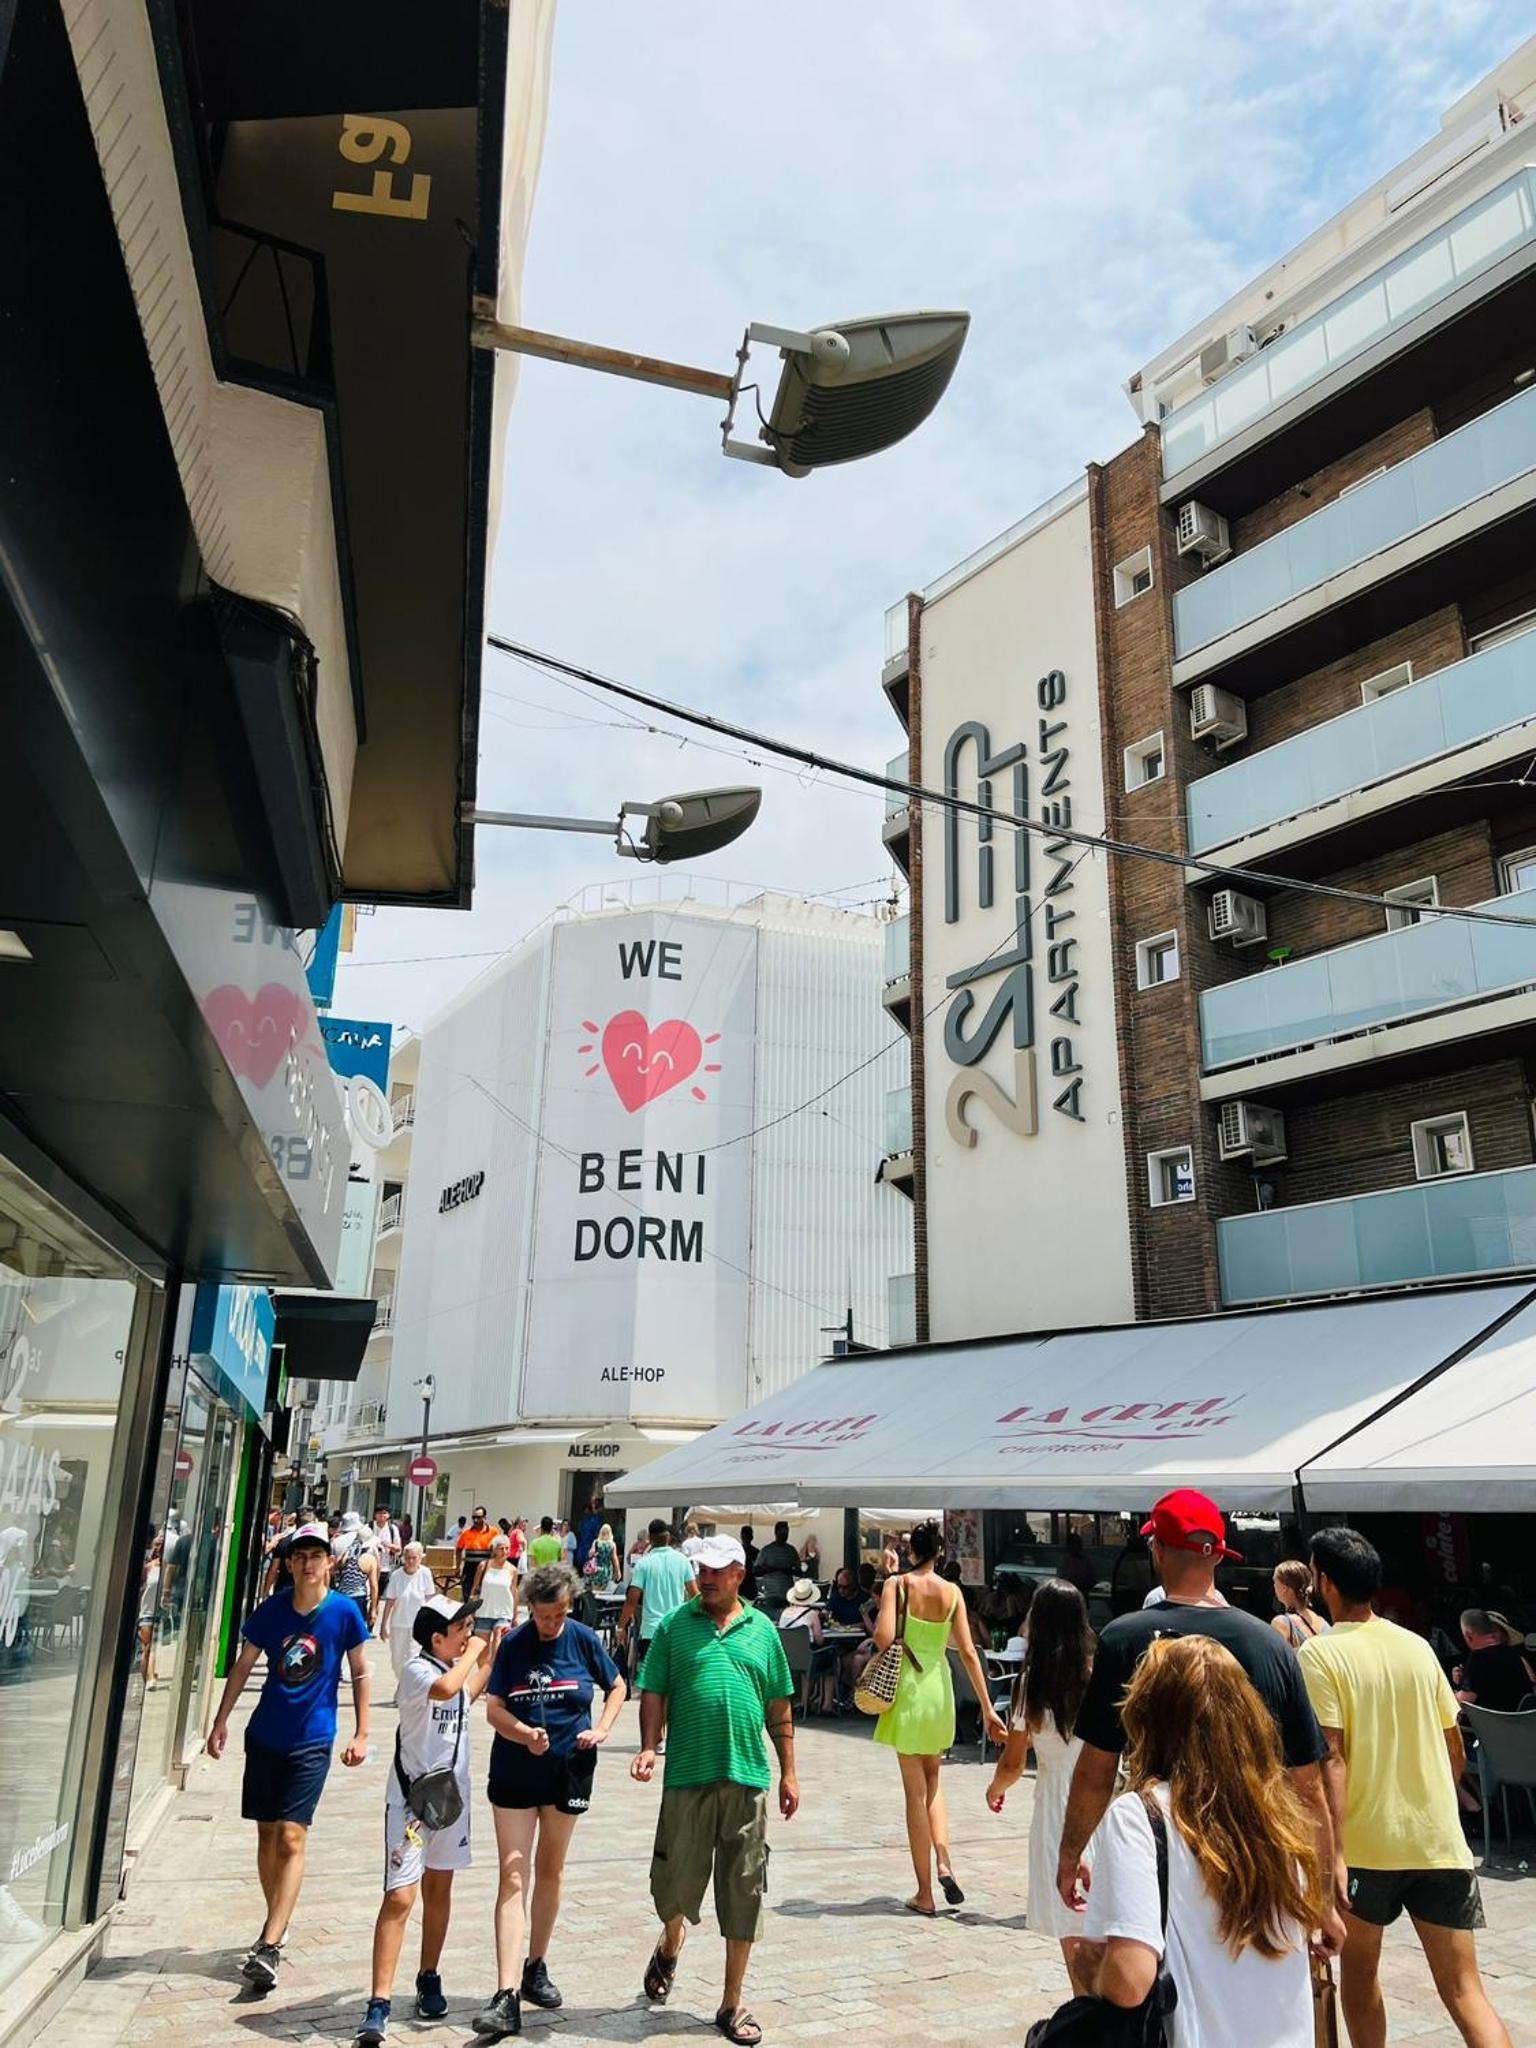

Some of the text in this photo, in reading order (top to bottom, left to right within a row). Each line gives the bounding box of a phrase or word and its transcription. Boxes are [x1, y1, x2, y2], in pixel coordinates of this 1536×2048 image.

[1037, 669, 1086, 1123] APARTMENTS
[618, 940, 684, 981] WE
[438, 1171, 485, 1213] ALE-HOP
[578, 1148, 705, 1196] BENI
[574, 1216, 704, 1263] DORM
[600, 1366, 666, 1383] ALE-HOP
[995, 1406, 1070, 1424] LA
[568, 1444, 620, 1458] ALE-HOP
[997, 1441, 1125, 1455] CHURRERIA
